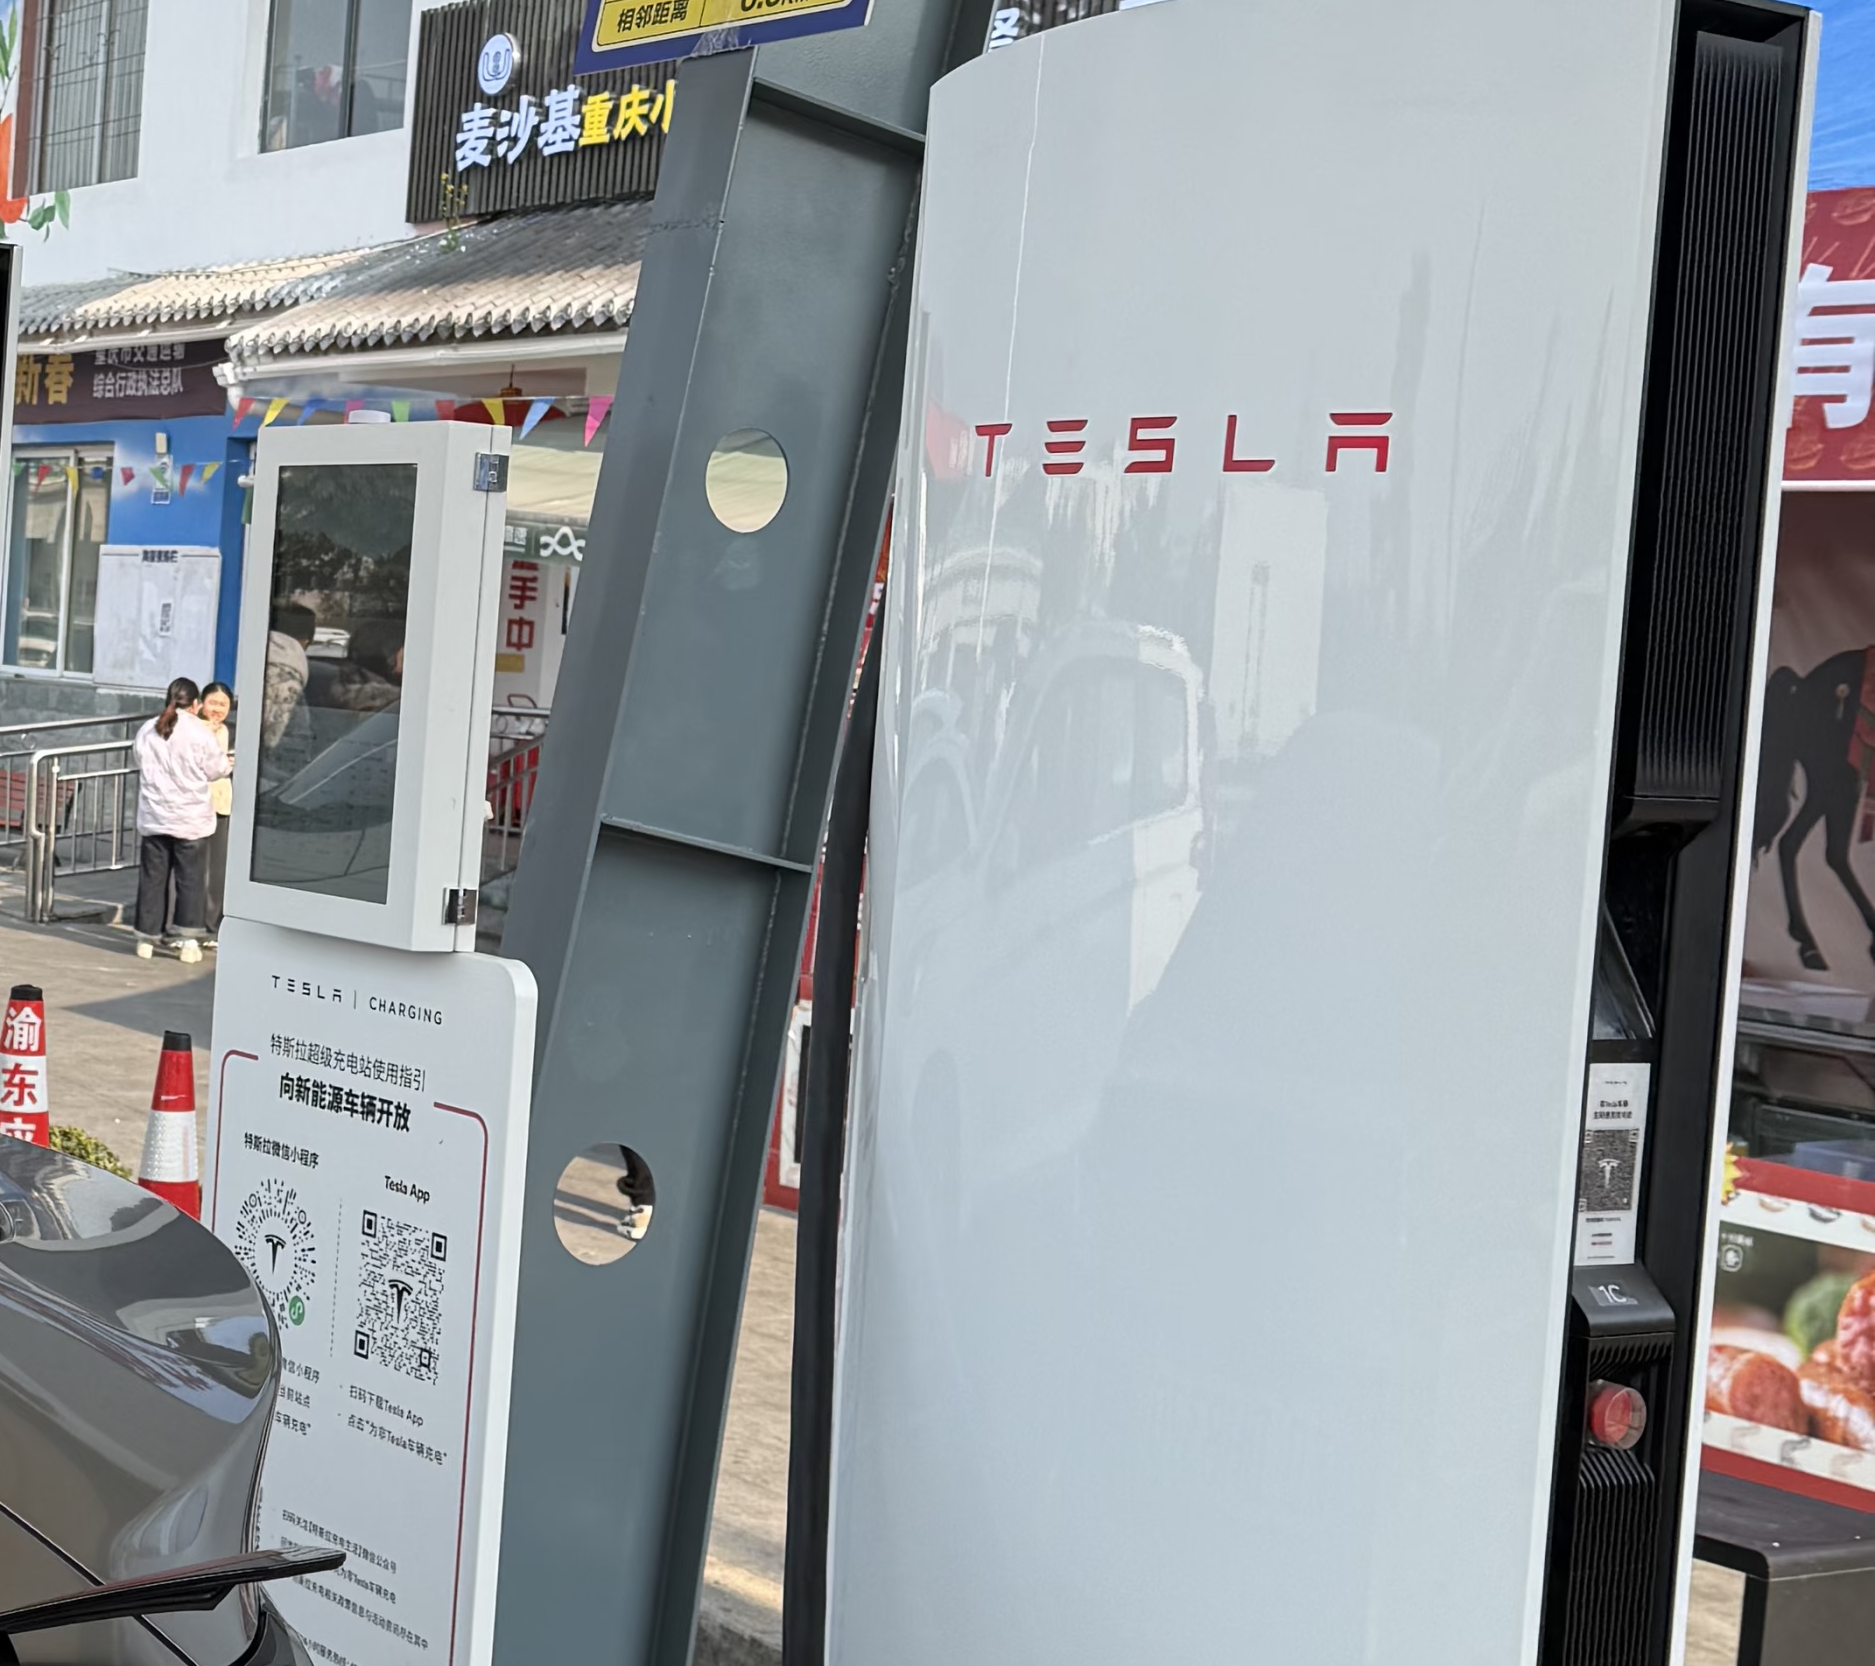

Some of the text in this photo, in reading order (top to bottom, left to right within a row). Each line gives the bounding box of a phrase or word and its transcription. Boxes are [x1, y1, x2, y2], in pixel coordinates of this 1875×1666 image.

[93, 367, 184, 399] 综合行政执法总队
[974, 411, 1393, 477] TESLA
[271, 975, 443, 1025] TESLA CHARGING
[270, 1033, 426, 1093] 特斯拉超级充电站使用指引
[279, 1072, 412, 1133] 向新能源车辆开放
[244, 1132, 320, 1169] 特斯拉微信小程序
[384, 1175, 431, 1204] Tesla App
[1598, 1283, 1628, 1304] 1C
